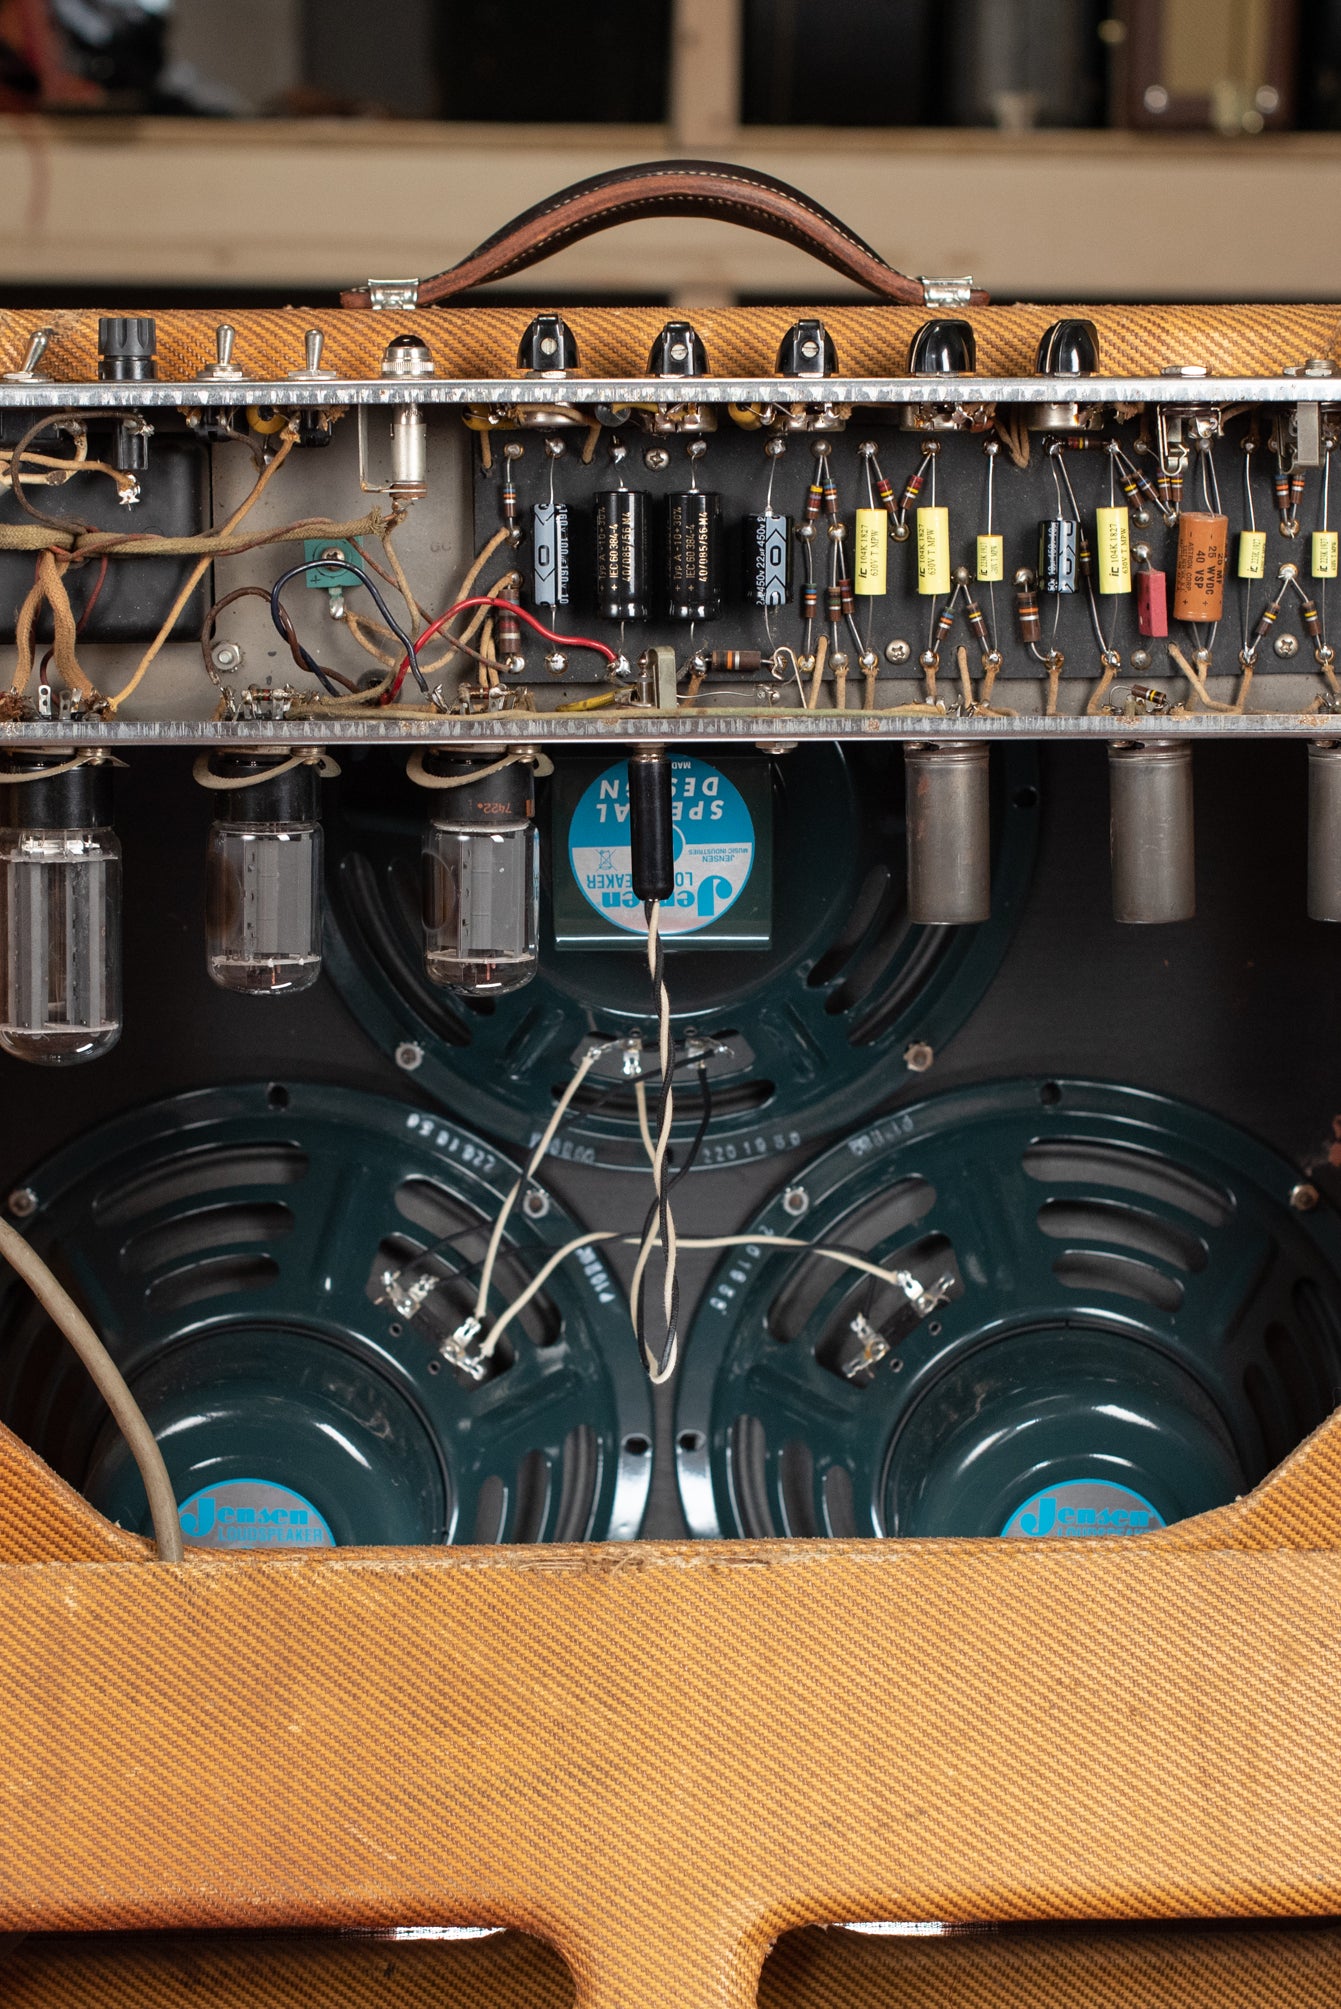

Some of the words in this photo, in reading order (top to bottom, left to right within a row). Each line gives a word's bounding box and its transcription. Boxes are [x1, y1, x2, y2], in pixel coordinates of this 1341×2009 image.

[622, 511, 631, 525] M4
[698, 511, 708, 525] M4
[609, 523, 619, 549] 384-4
[686, 523, 695, 550] 384-4
[860, 524, 868, 542] 1827
[870, 529, 878, 548] MPW
[927, 528, 935, 547] MPW
[1109, 523, 1118, 541] 1827
[609, 551, 619, 562] 60
[622, 527, 632, 582] 40/085/56
[673, 553, 683, 561] A
[686, 551, 695, 562] 60
[698, 527, 708, 582] 40/085/56
[860, 545, 868, 564] 104K
[1110, 543, 1119, 563] 104K
[1186, 542, 1194, 569] ASTRON
[1195, 550, 1205, 563] 40
[1208, 545, 1217, 558] 25
[609, 563, 619, 578] IEC
[673, 565, 683, 580] Typ
[686, 563, 695, 579] IEC
[870, 558, 879, 577] 630V
[928, 557, 936, 576] 630V
[1194, 569, 1204, 589] VSP
[1206, 566, 1216, 595] WVDC
[601, 776, 719, 799] DEN
[596, 800, 725, 822] SPEAL
[702, 854, 735, 863] JENSEN
[586, 872, 693, 889] LOEAKER
[602, 875, 733, 917] Jenen
[180, 1497, 309, 1537] Jensen
[1020, 1497, 1149, 1536] Jensen
[218, 1526, 322, 1542] LOUDSPEAKER
